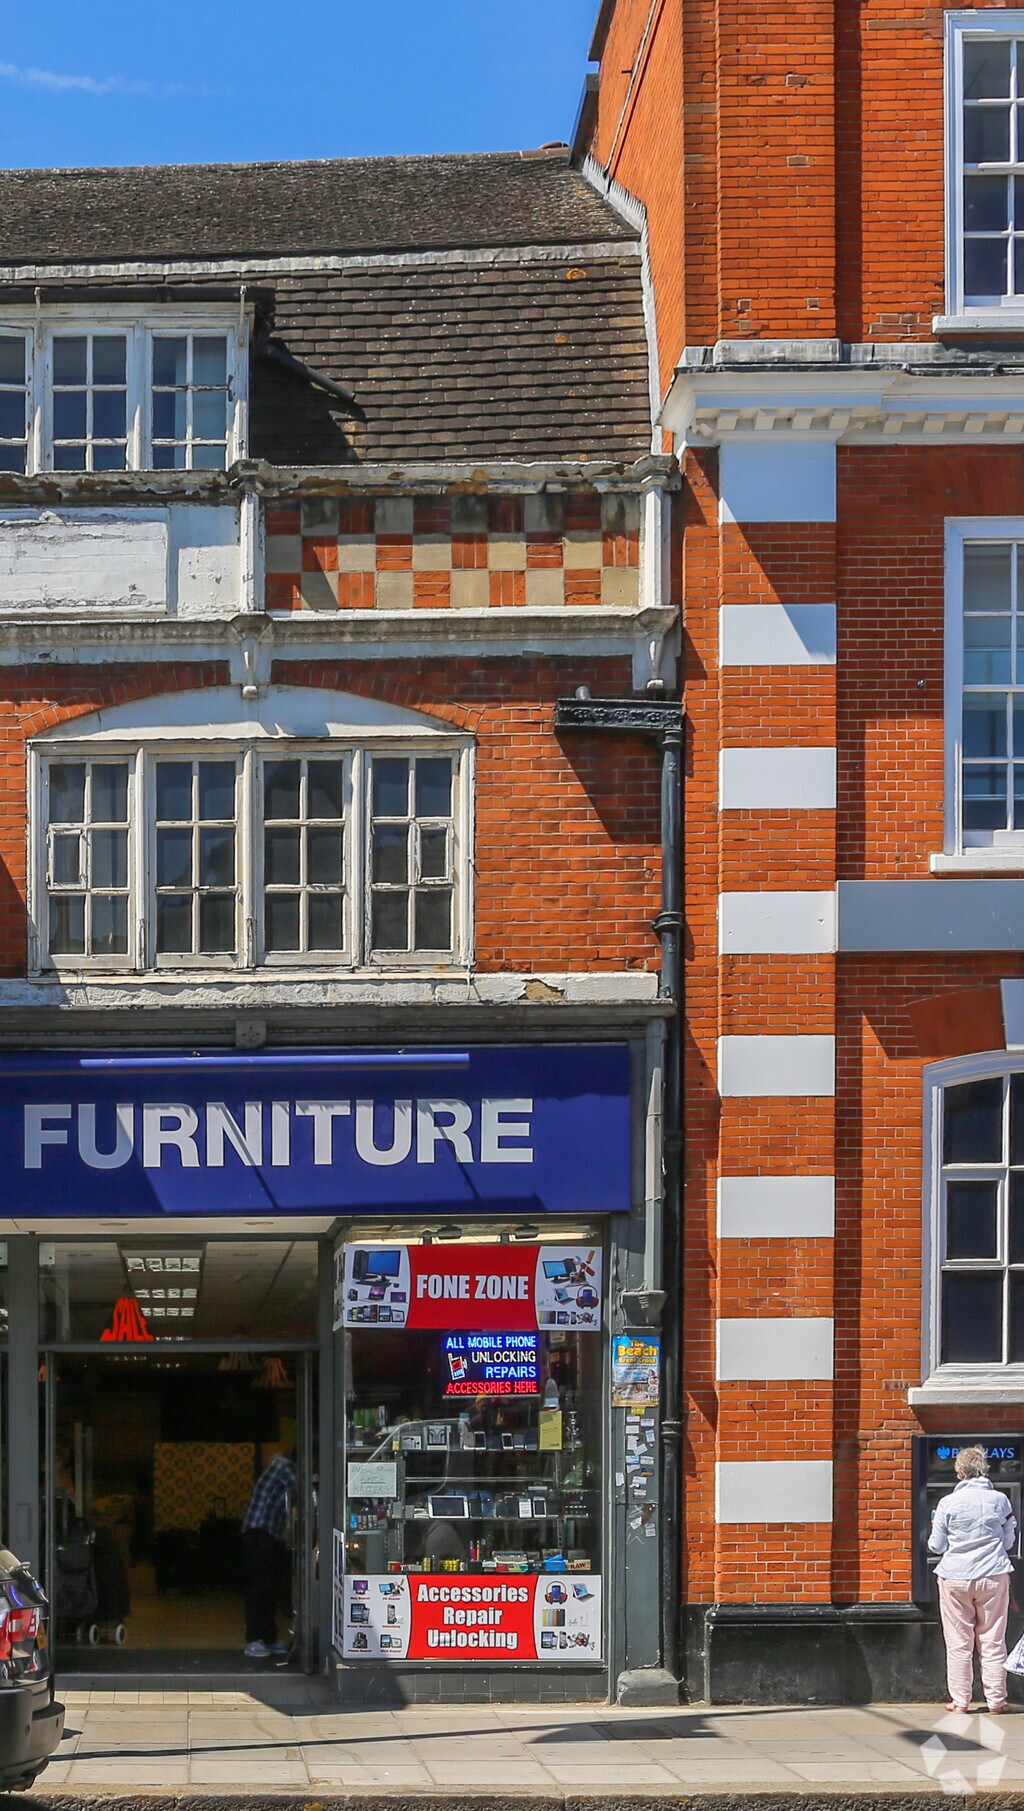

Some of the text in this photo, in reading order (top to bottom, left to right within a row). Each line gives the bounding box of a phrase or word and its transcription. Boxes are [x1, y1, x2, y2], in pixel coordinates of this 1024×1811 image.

[24, 1098, 534, 1169] FURNITURE
[416, 1274, 529, 1300] FONE ZONE
[446, 1336, 536, 1348] ALL MOBILE PHONE
[471, 1351, 536, 1363] UNLOCKING
[617, 1345, 657, 1356] Beach
[485, 1366, 536, 1378] REPAIRS
[446, 1381, 538, 1394] ACCESSORIES HERE
[951, 1447, 1014, 1459] BLAYS
[417, 1584, 529, 1602] Accessories
[443, 1606, 503, 1626] Repair
[427, 1629, 518, 1650] Unlocking
